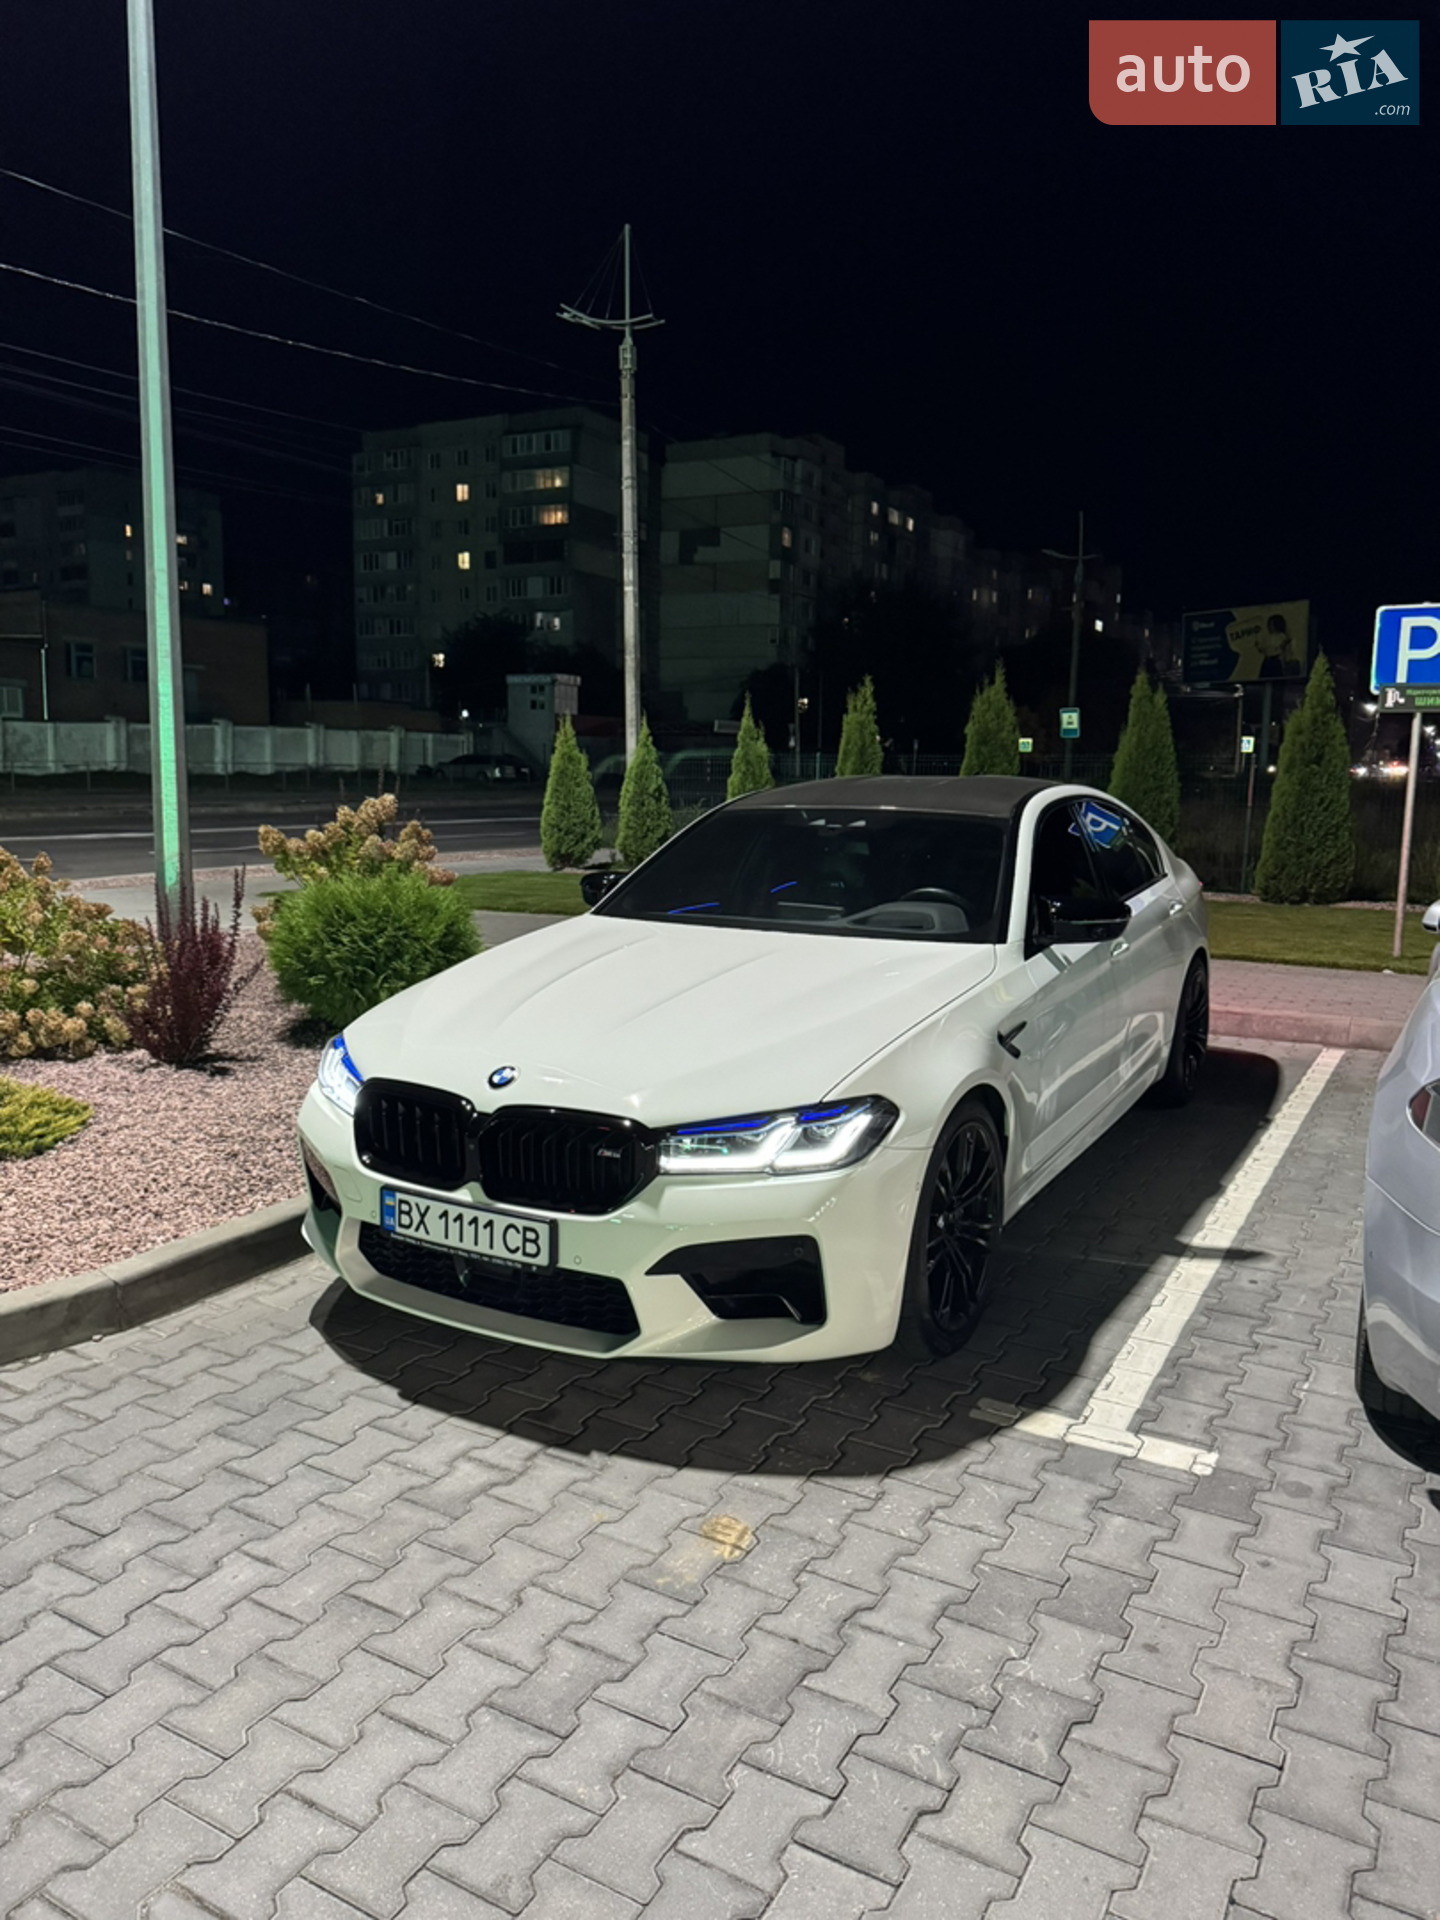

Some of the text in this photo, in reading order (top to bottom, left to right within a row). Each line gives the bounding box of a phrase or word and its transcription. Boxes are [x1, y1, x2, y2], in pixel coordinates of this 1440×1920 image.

[1396, 616, 1440, 684] P
[397, 1198, 431, 1236] BX
[438, 1209, 494, 1250] 1111
[502, 1223, 542, 1259] CB
